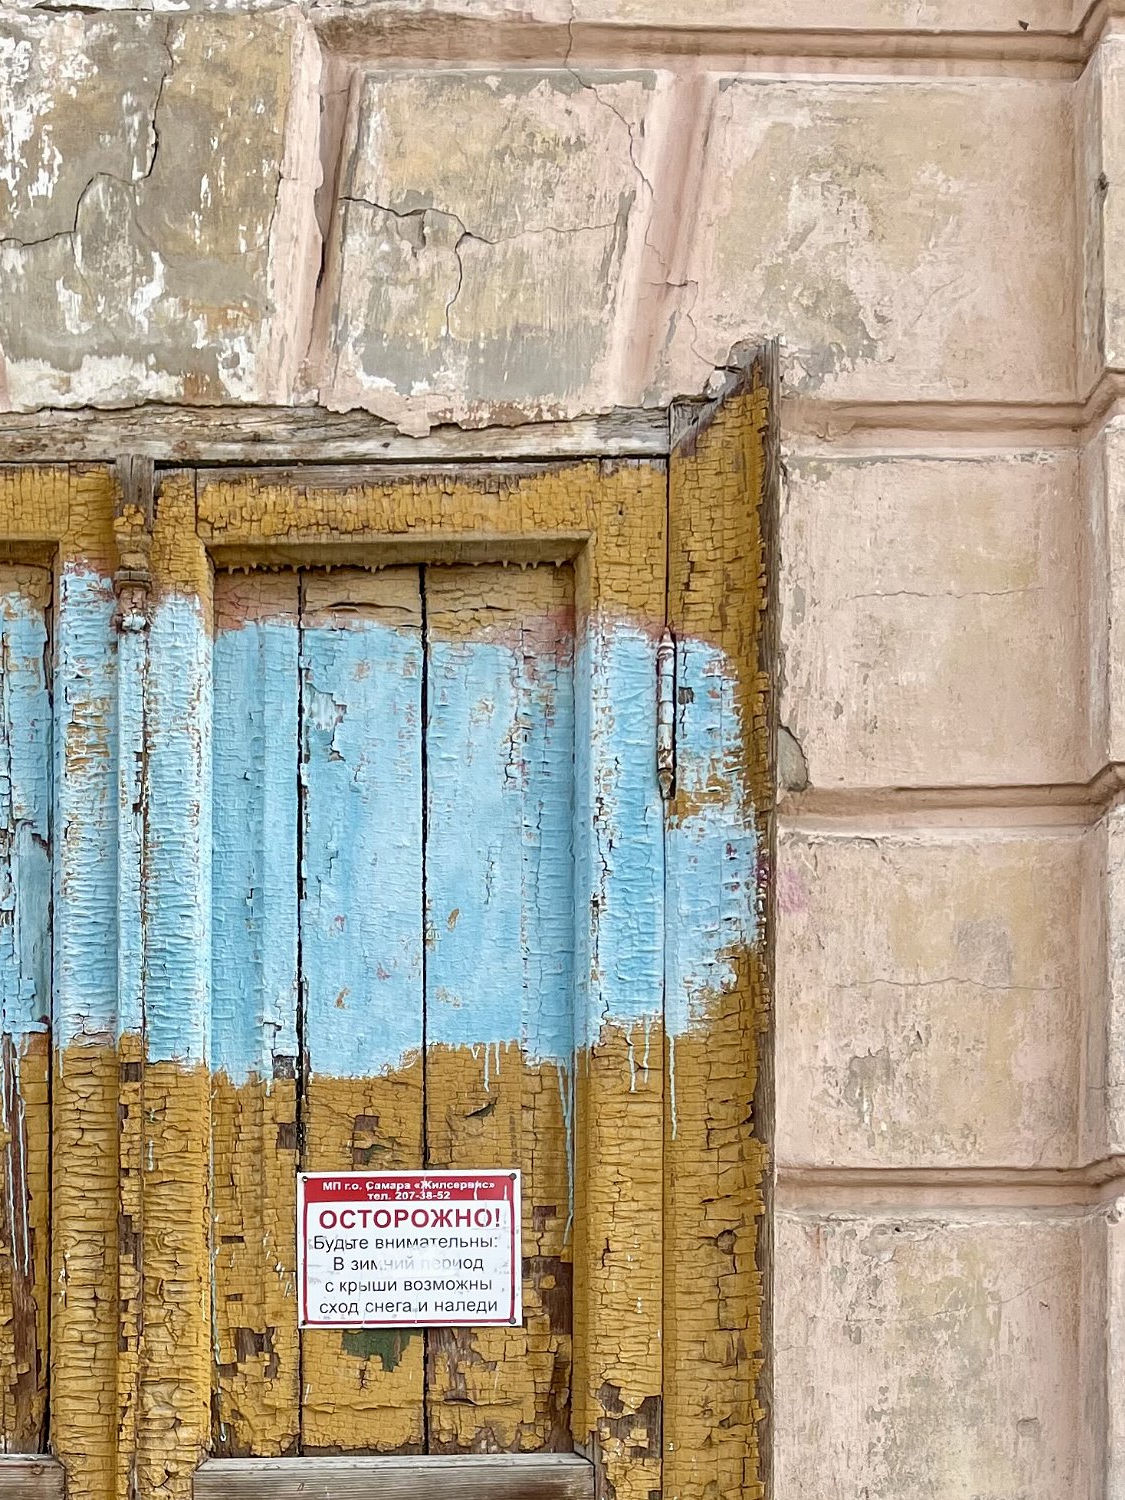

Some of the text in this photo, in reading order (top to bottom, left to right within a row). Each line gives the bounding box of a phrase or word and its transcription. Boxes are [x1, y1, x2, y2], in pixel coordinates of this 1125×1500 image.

[323, 1182, 341, 1190] МП
[366, 1182, 411, 1191] Самара
[319, 1208, 500, 1229] ОСТОРОЖНО!
[314, 1236, 497, 1252] Будьте внимательны:
[334, 1257, 344, 1271] В
[325, 1279, 492, 1295] с крыши возможны
[320, 1299, 497, 1315] сход снега и наледи
